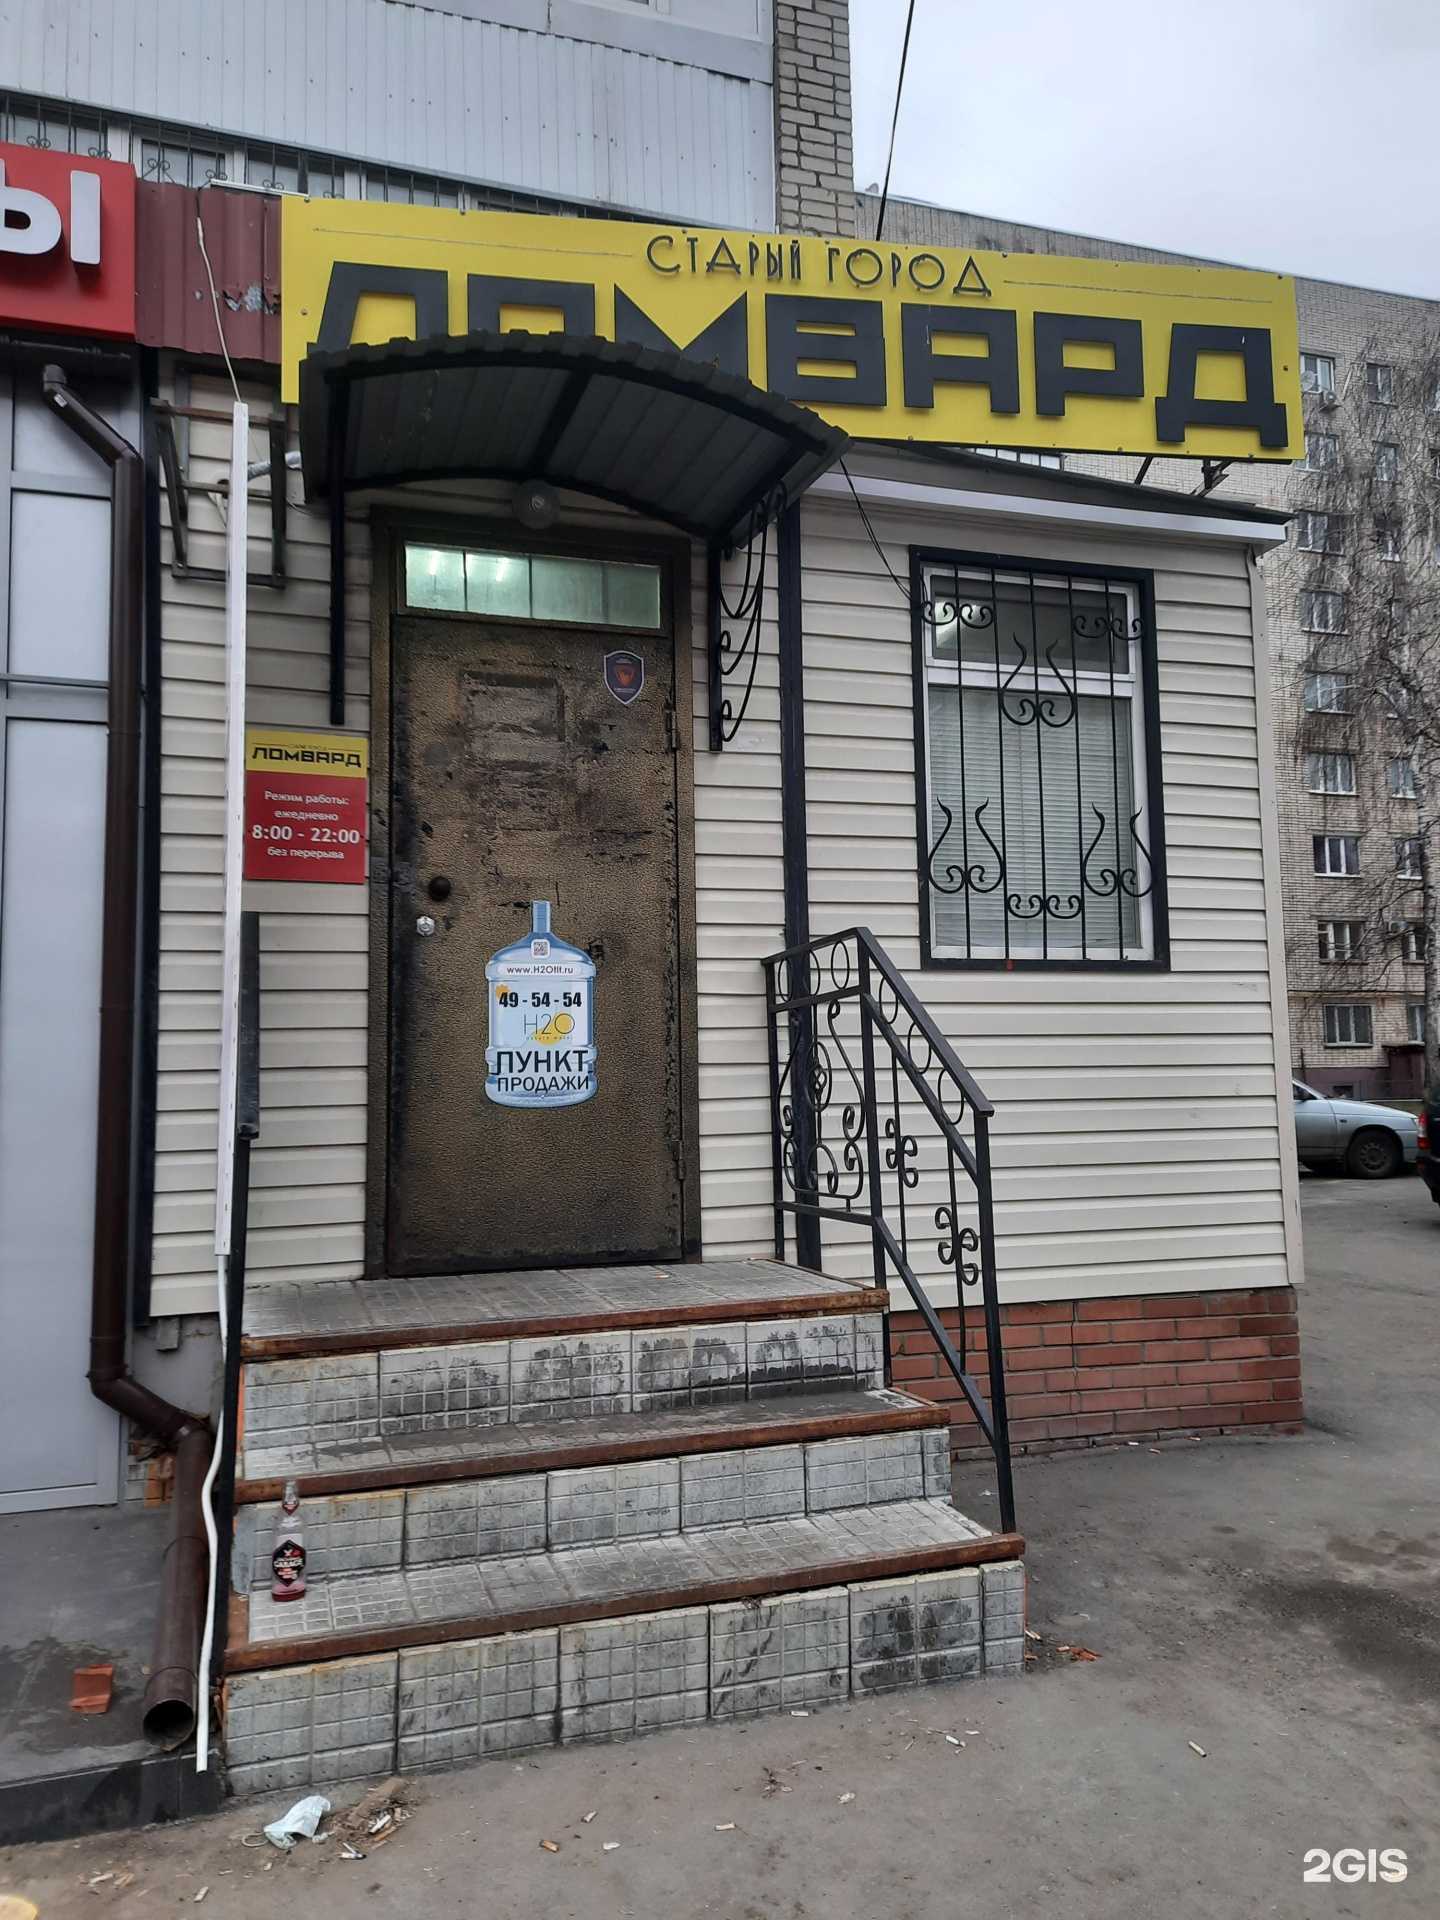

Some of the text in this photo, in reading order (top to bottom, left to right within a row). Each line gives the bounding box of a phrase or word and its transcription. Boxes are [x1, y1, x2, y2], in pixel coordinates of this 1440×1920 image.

[646, 235, 992, 297] СТАРЫЙ ГОРОД
[264, 790, 349, 806] Режим работы:
[274, 809, 339, 822] ежедневно
[252, 824, 293, 841] 8:00
[310, 827, 360, 844] 22:00
[267, 846, 345, 860] без перерыва
[523, 1013, 576, 1035] H2O
[496, 1050, 590, 1074] ПУНКТ
[497, 1075, 590, 1094] ПРОДАЖИ
